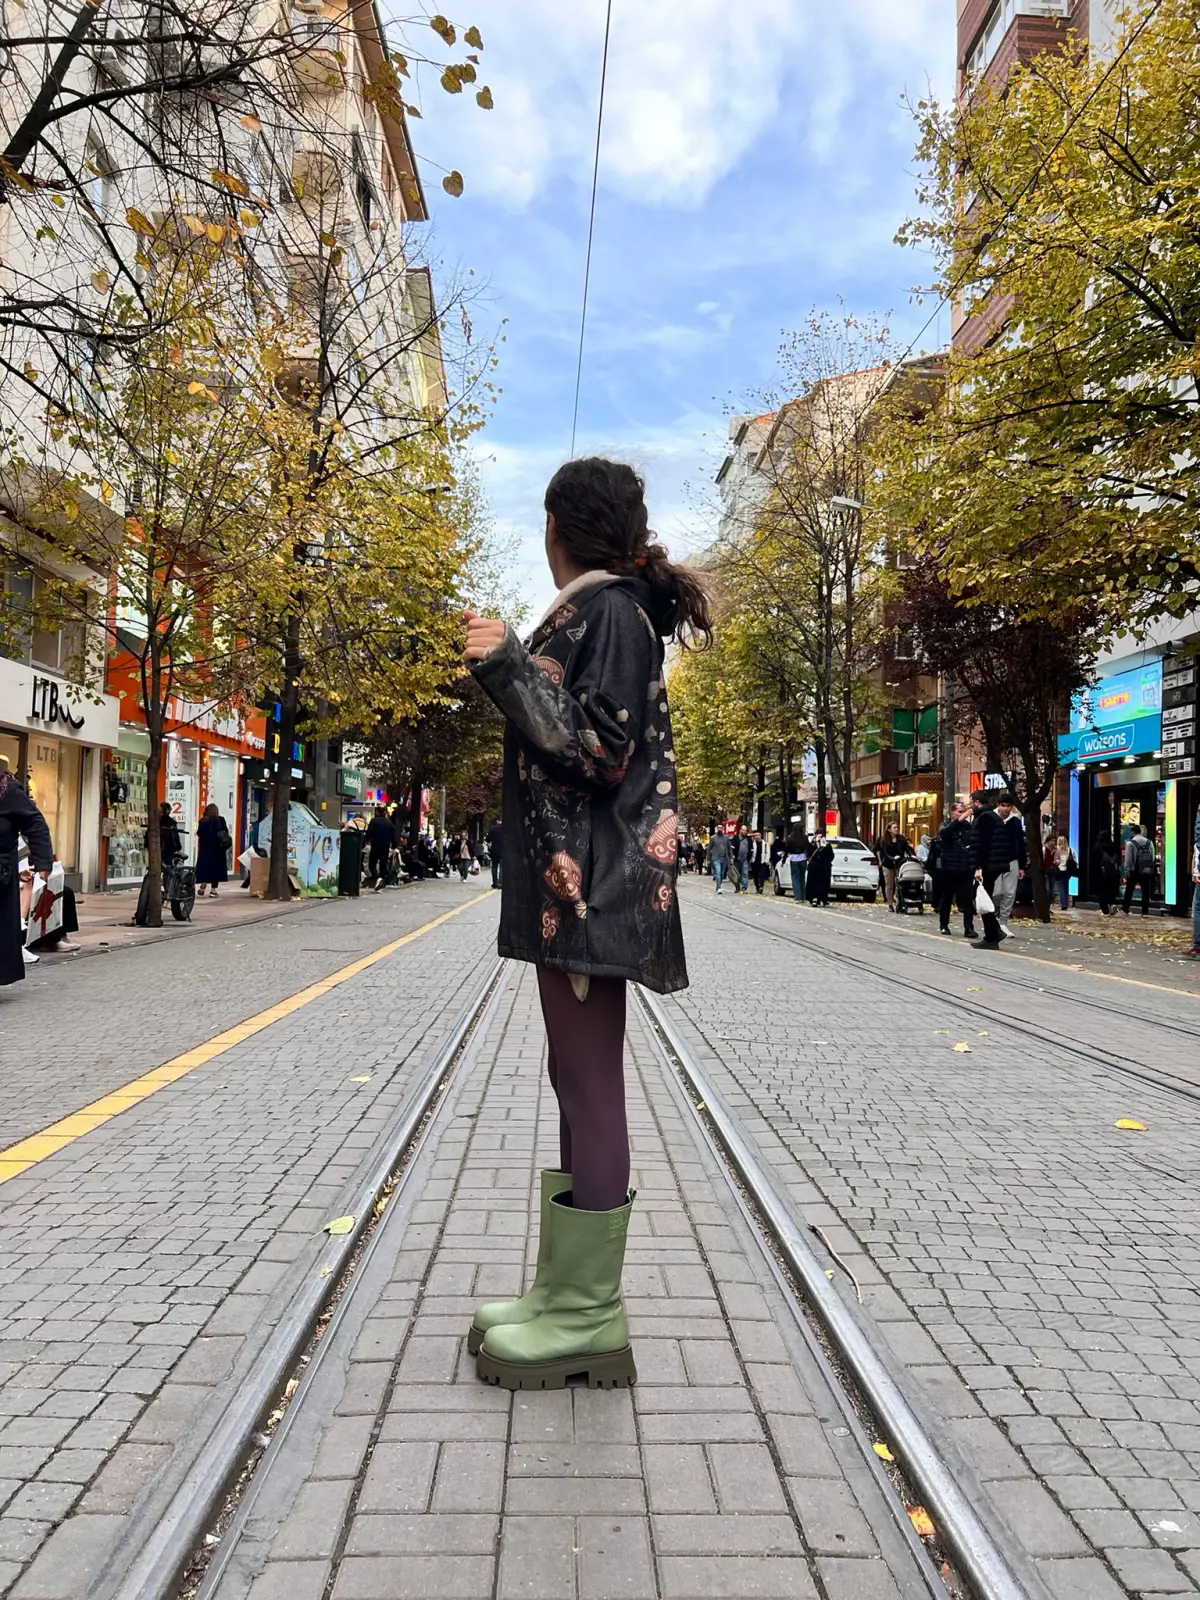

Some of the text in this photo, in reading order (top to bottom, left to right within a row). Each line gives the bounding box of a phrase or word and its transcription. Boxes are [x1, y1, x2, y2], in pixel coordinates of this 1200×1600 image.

[31, 675, 59, 723] LTB
[1084, 732, 1126, 752] watsons
[36, 745, 57, 762] LTB
